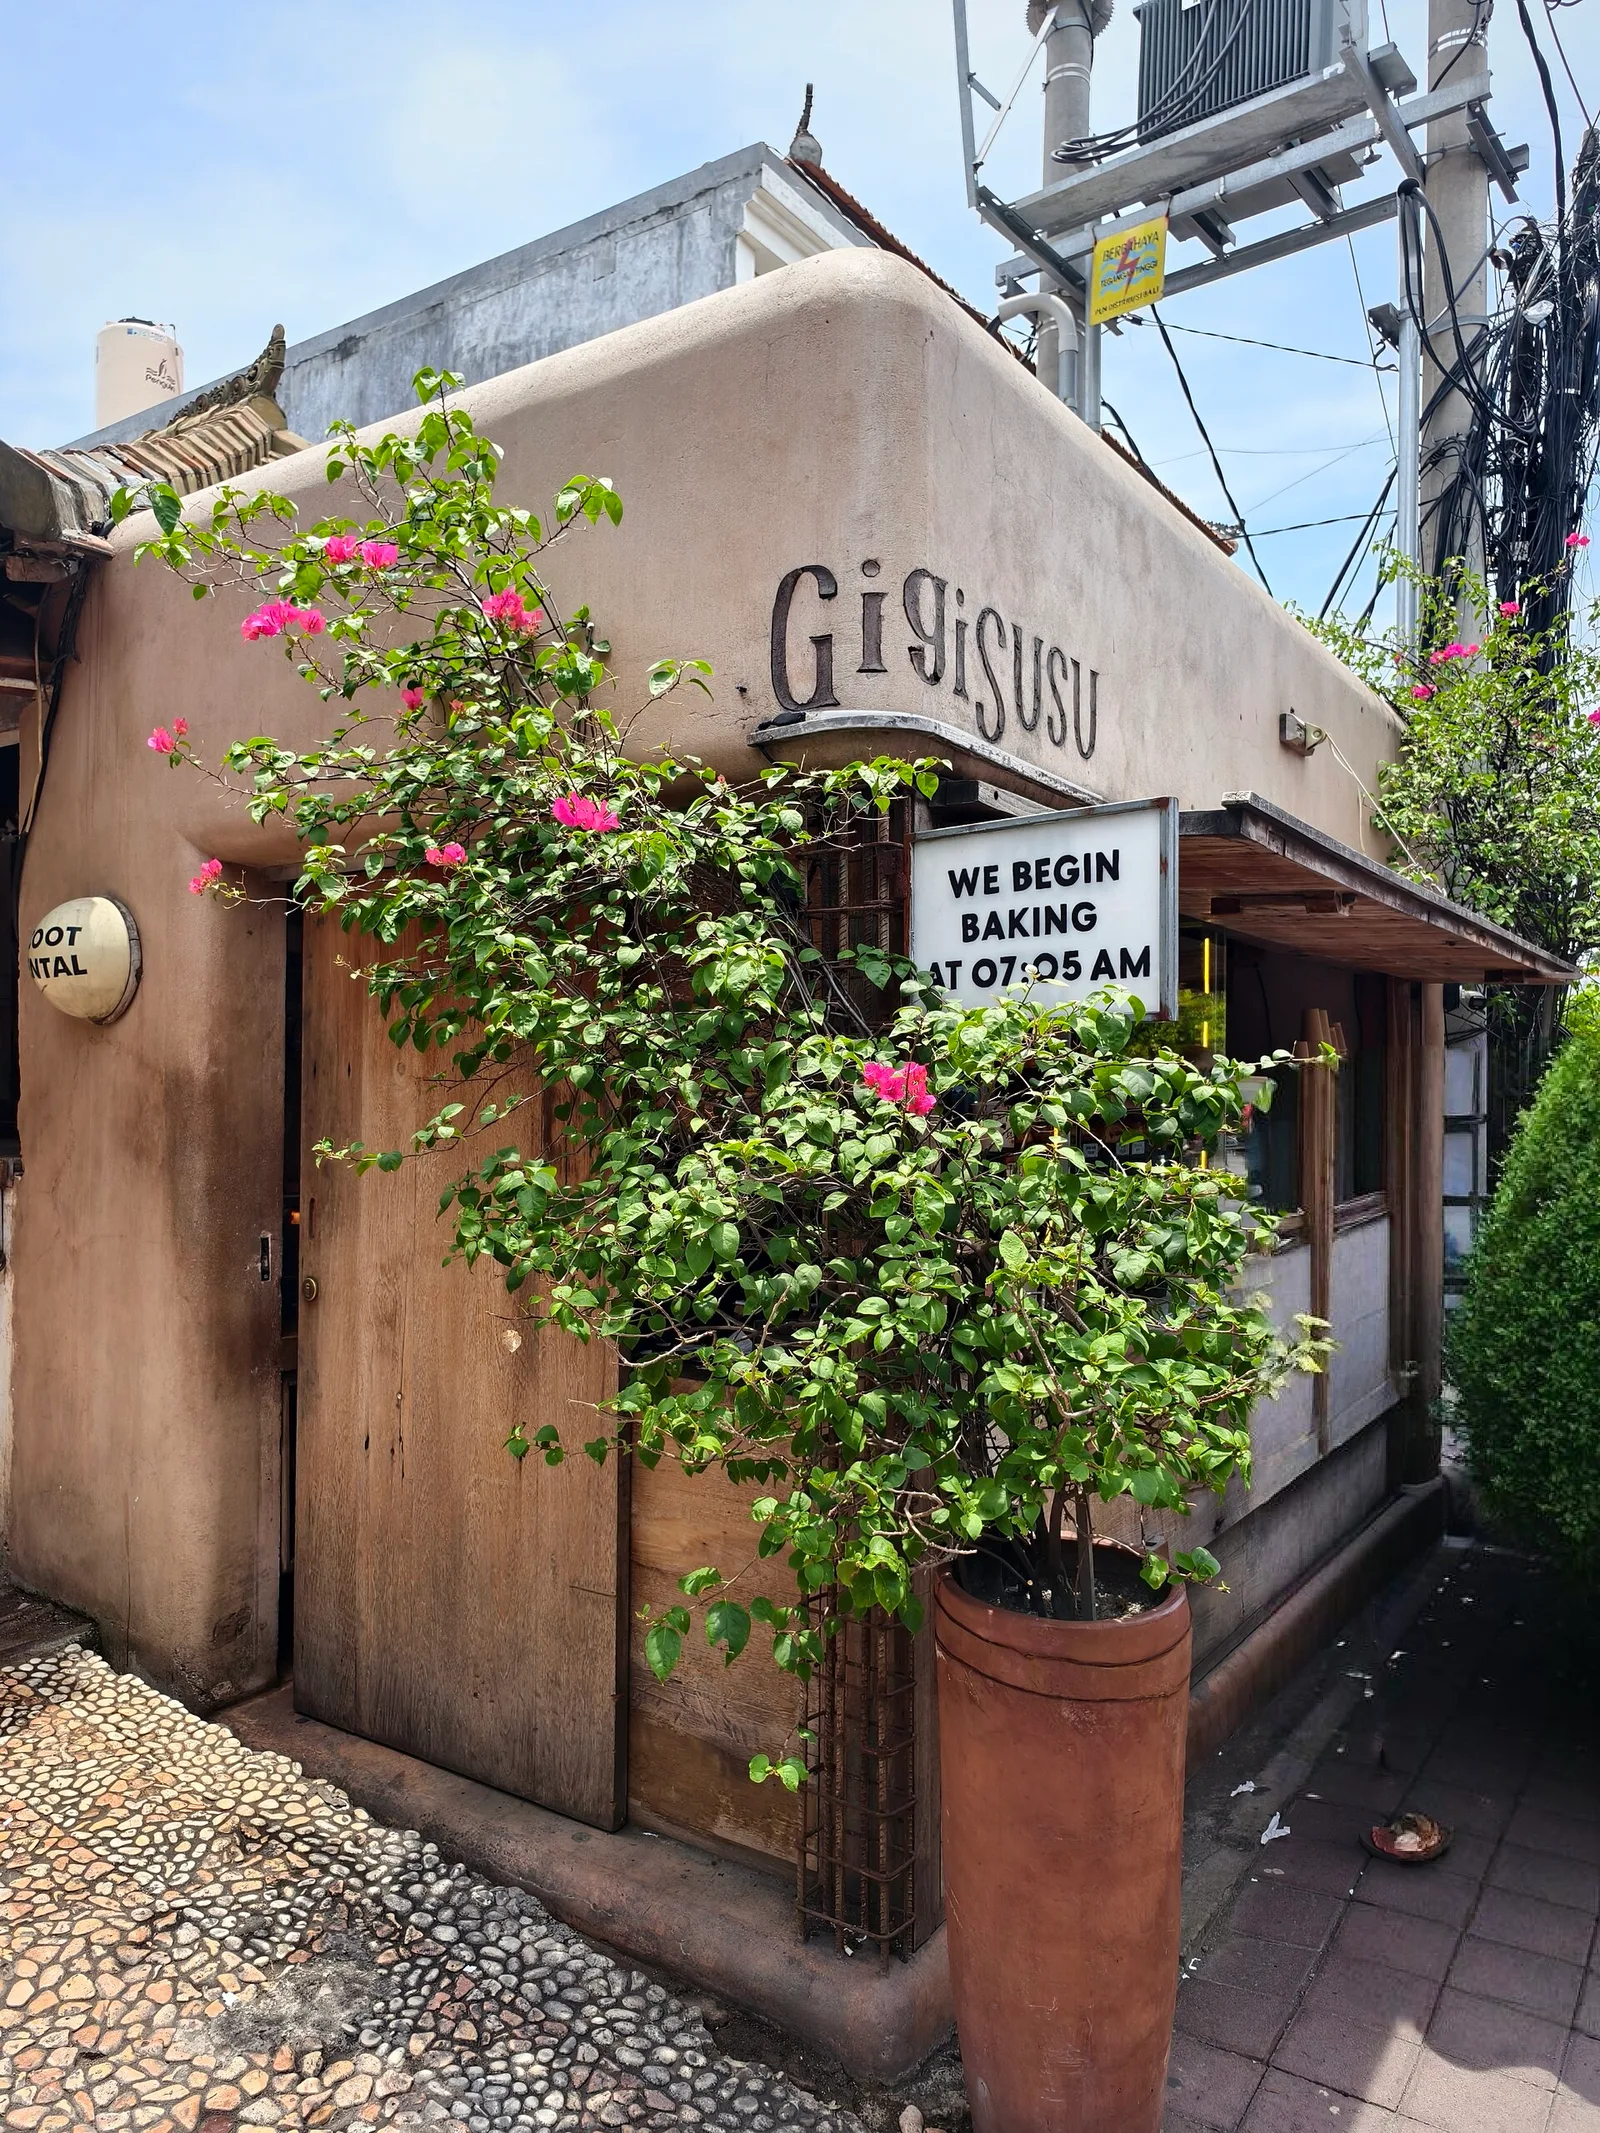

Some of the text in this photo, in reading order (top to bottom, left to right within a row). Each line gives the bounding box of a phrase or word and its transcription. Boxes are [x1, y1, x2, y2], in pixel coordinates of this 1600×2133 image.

[948, 849, 1120, 898] WE BEGIN
[29, 926, 82, 948] OOT
[961, 901, 1097, 943] BAKING
[929, 945, 1151, 990] AT 07:05 AM
